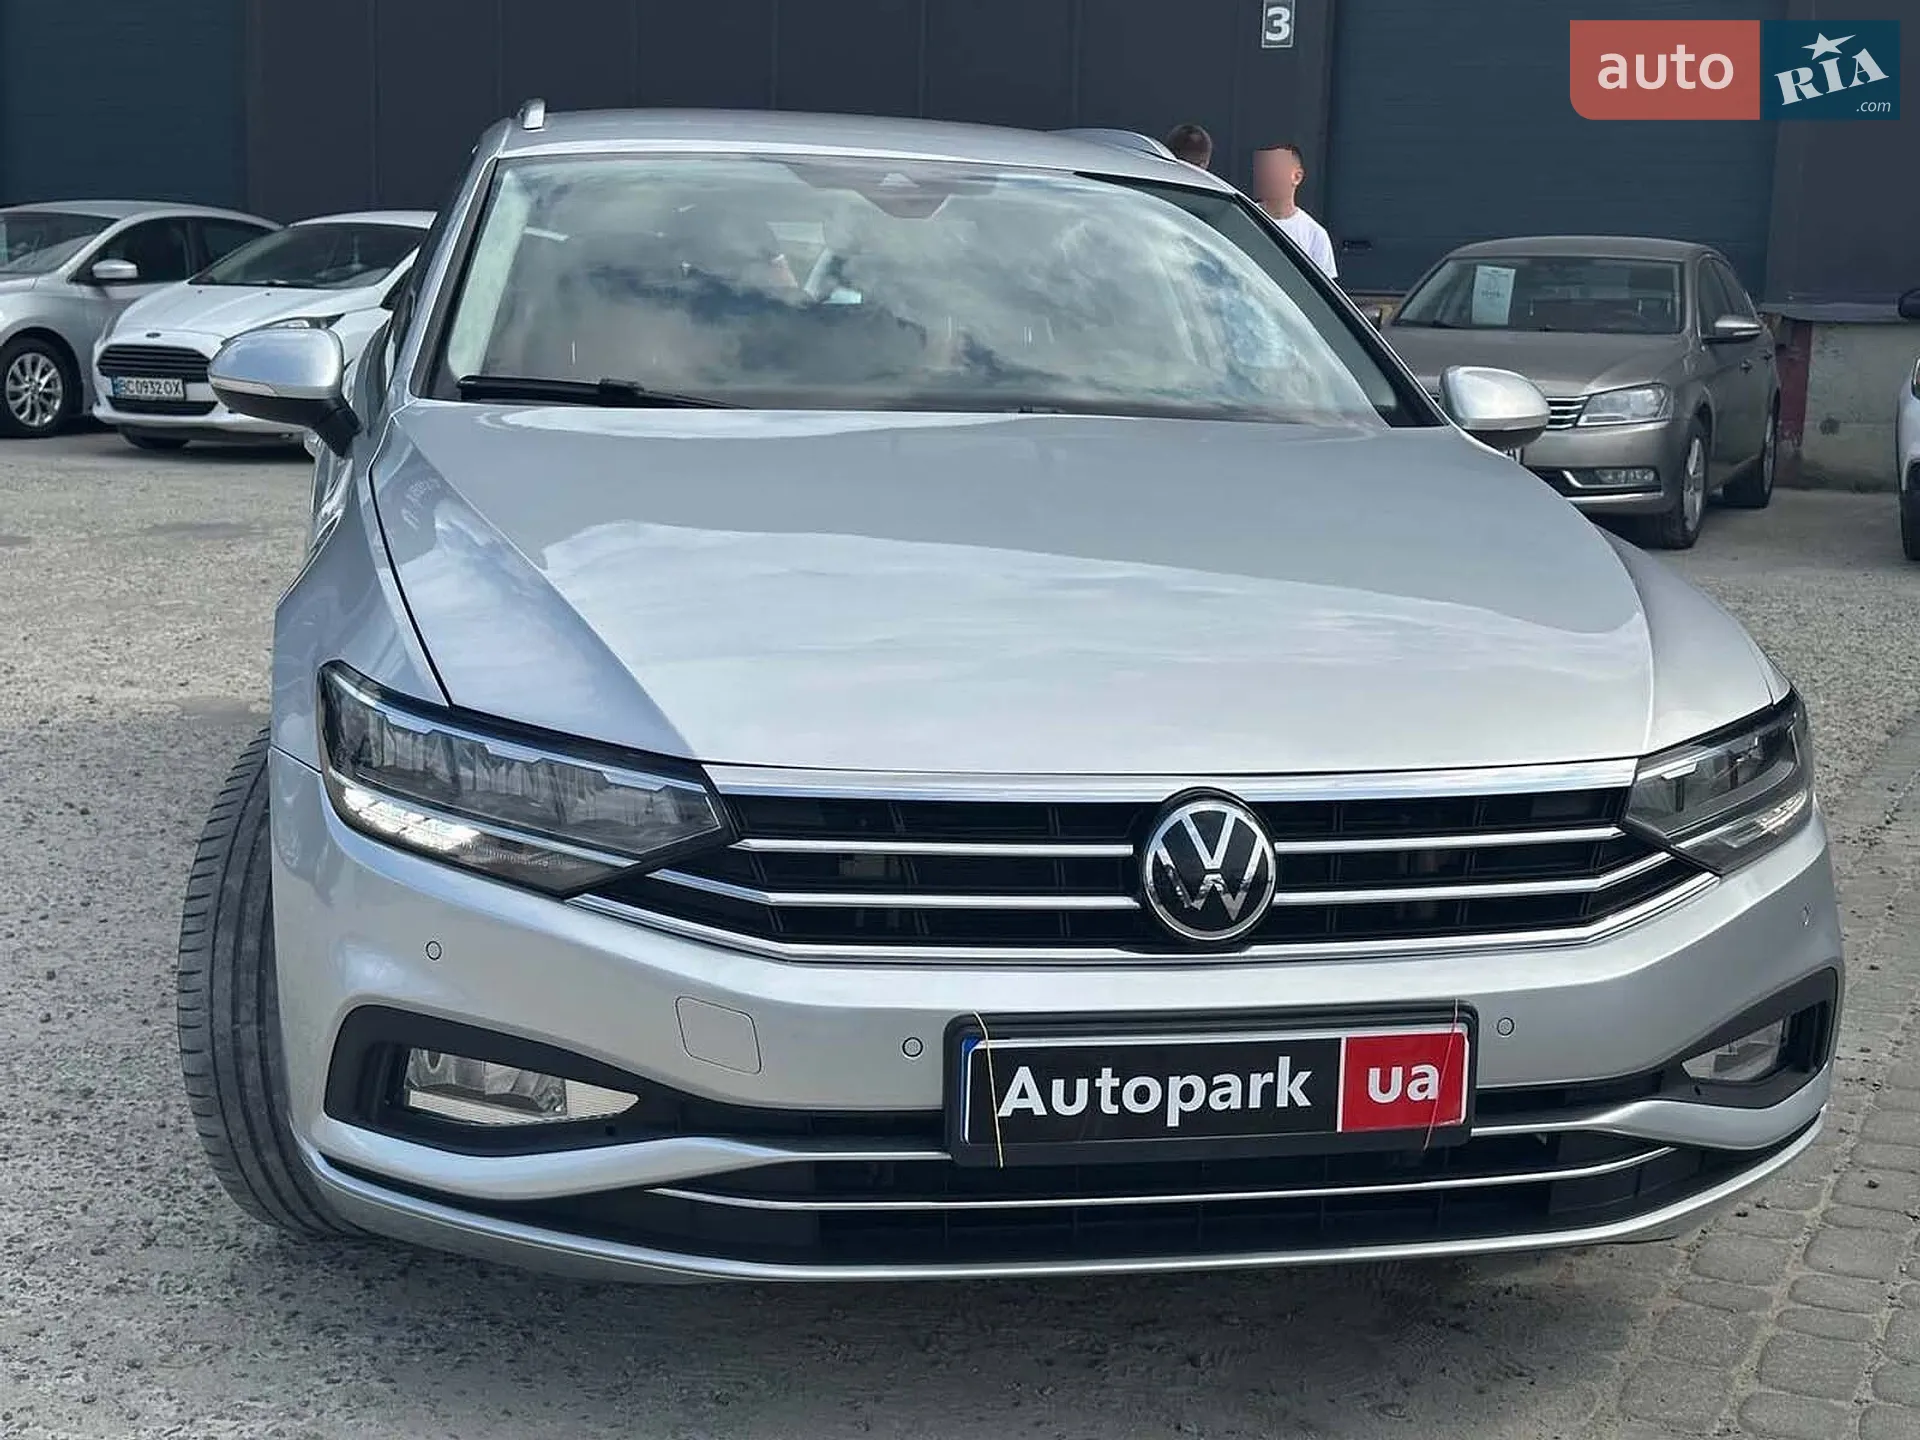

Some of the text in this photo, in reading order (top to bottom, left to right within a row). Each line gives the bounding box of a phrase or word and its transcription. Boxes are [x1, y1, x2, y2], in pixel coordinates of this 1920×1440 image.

[1265, 6, 1290, 41] 3
[997, 1056, 1439, 1127] Autopark ua
